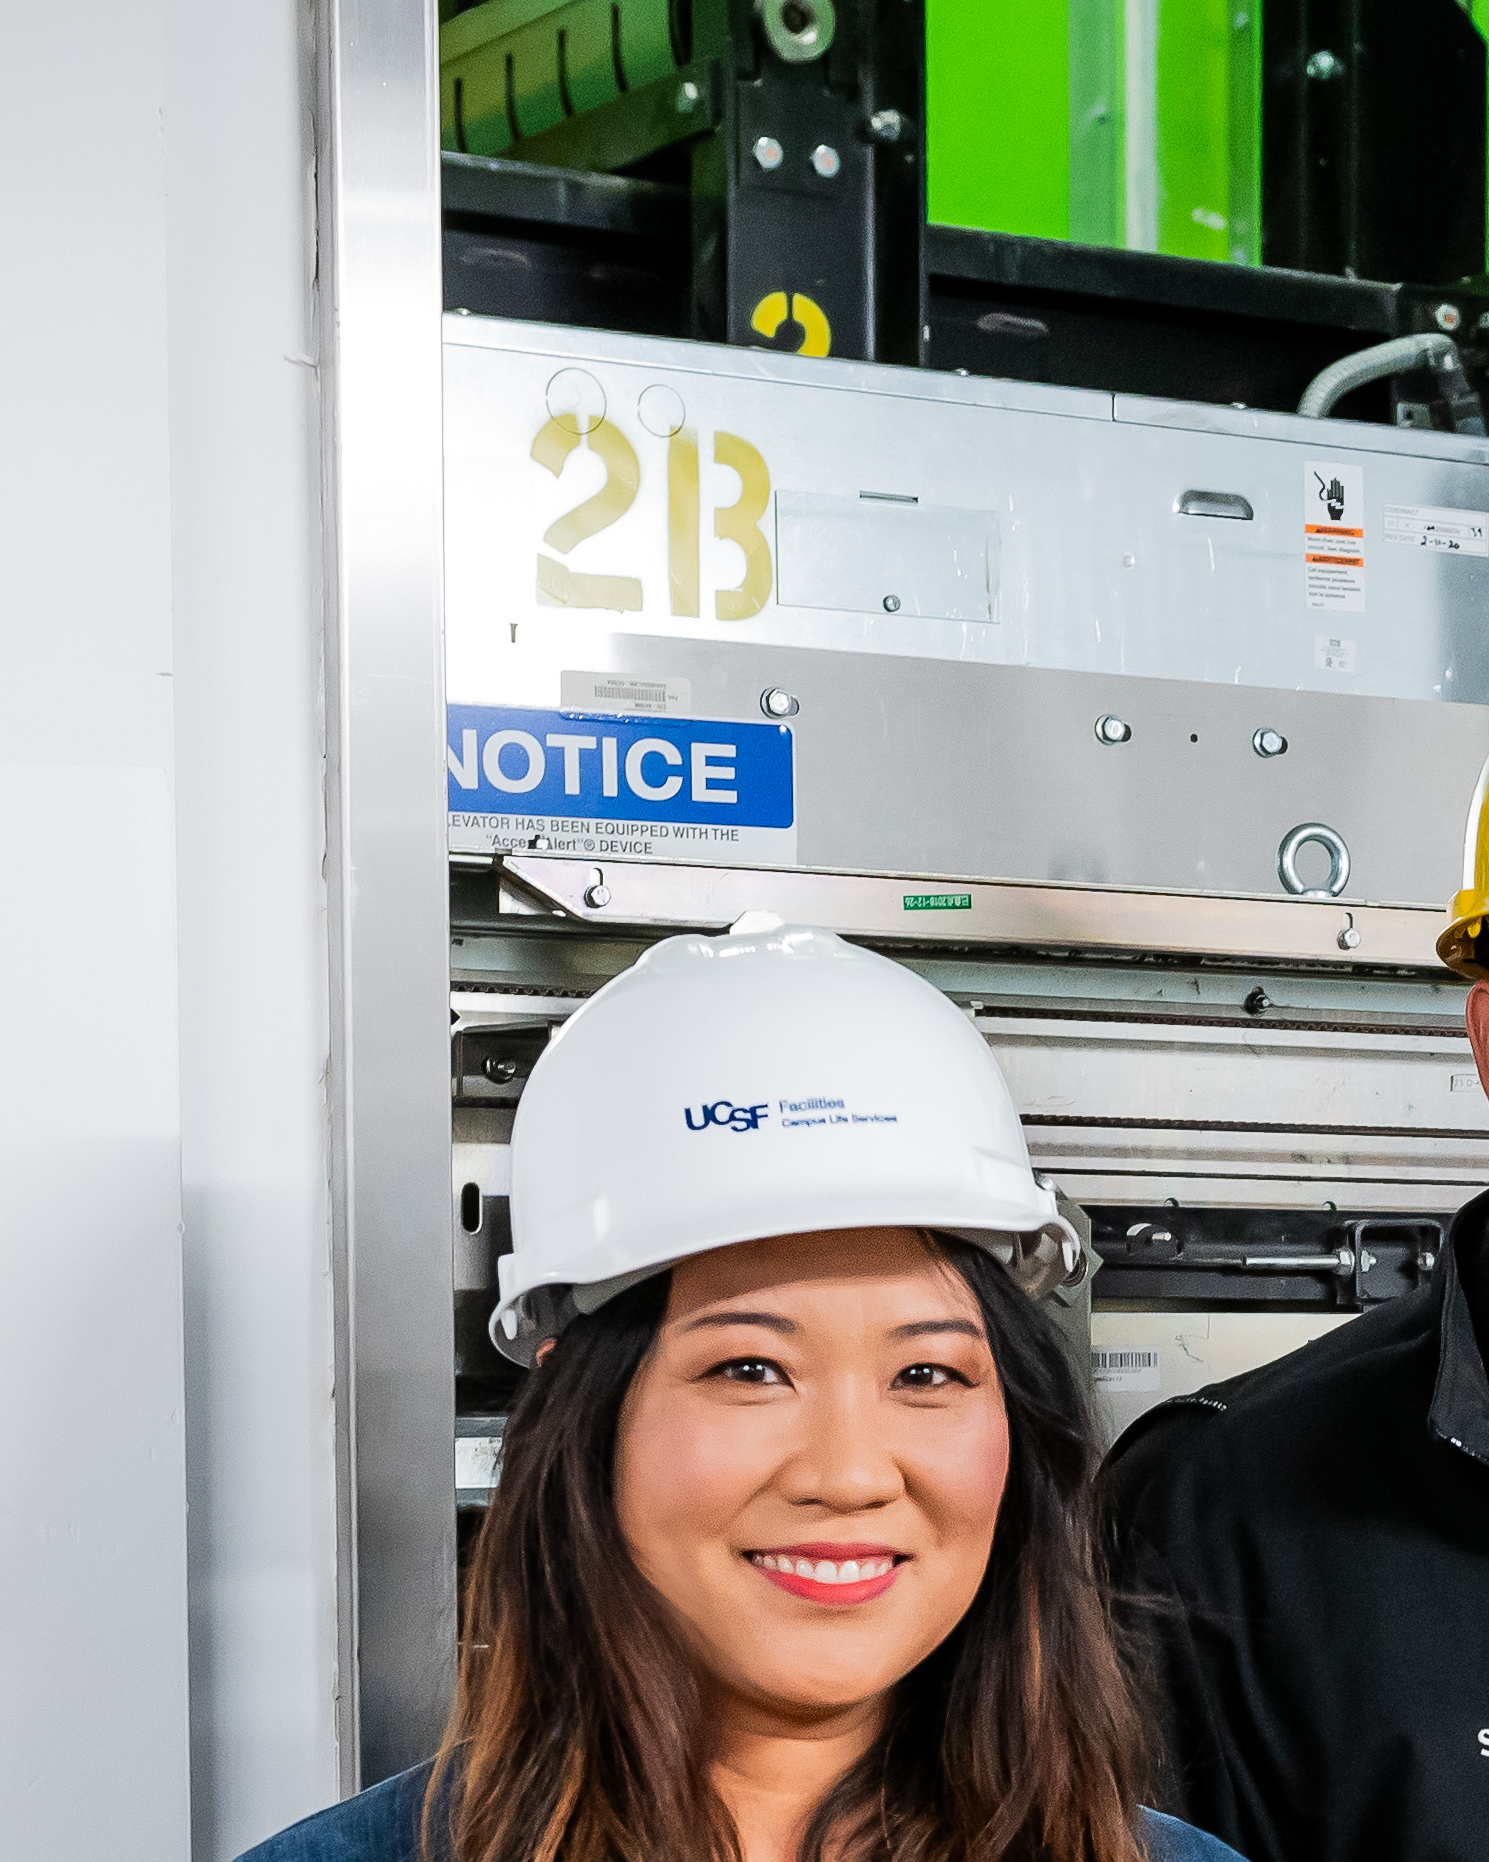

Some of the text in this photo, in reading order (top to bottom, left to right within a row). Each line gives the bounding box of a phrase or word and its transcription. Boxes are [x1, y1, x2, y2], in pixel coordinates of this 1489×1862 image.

[529, 412, 773, 621] 2B
[515, 817, 545, 832] HAS
[550, 819, 590, 834] BEEN
[595, 822, 669, 838] EQUIPPED
[669, 825, 708, 840] WITH
[712, 828, 739, 842] THE
[599, 840, 653, 854] DEVICE
[684, 1097, 845, 1132] UCSF Facilities
